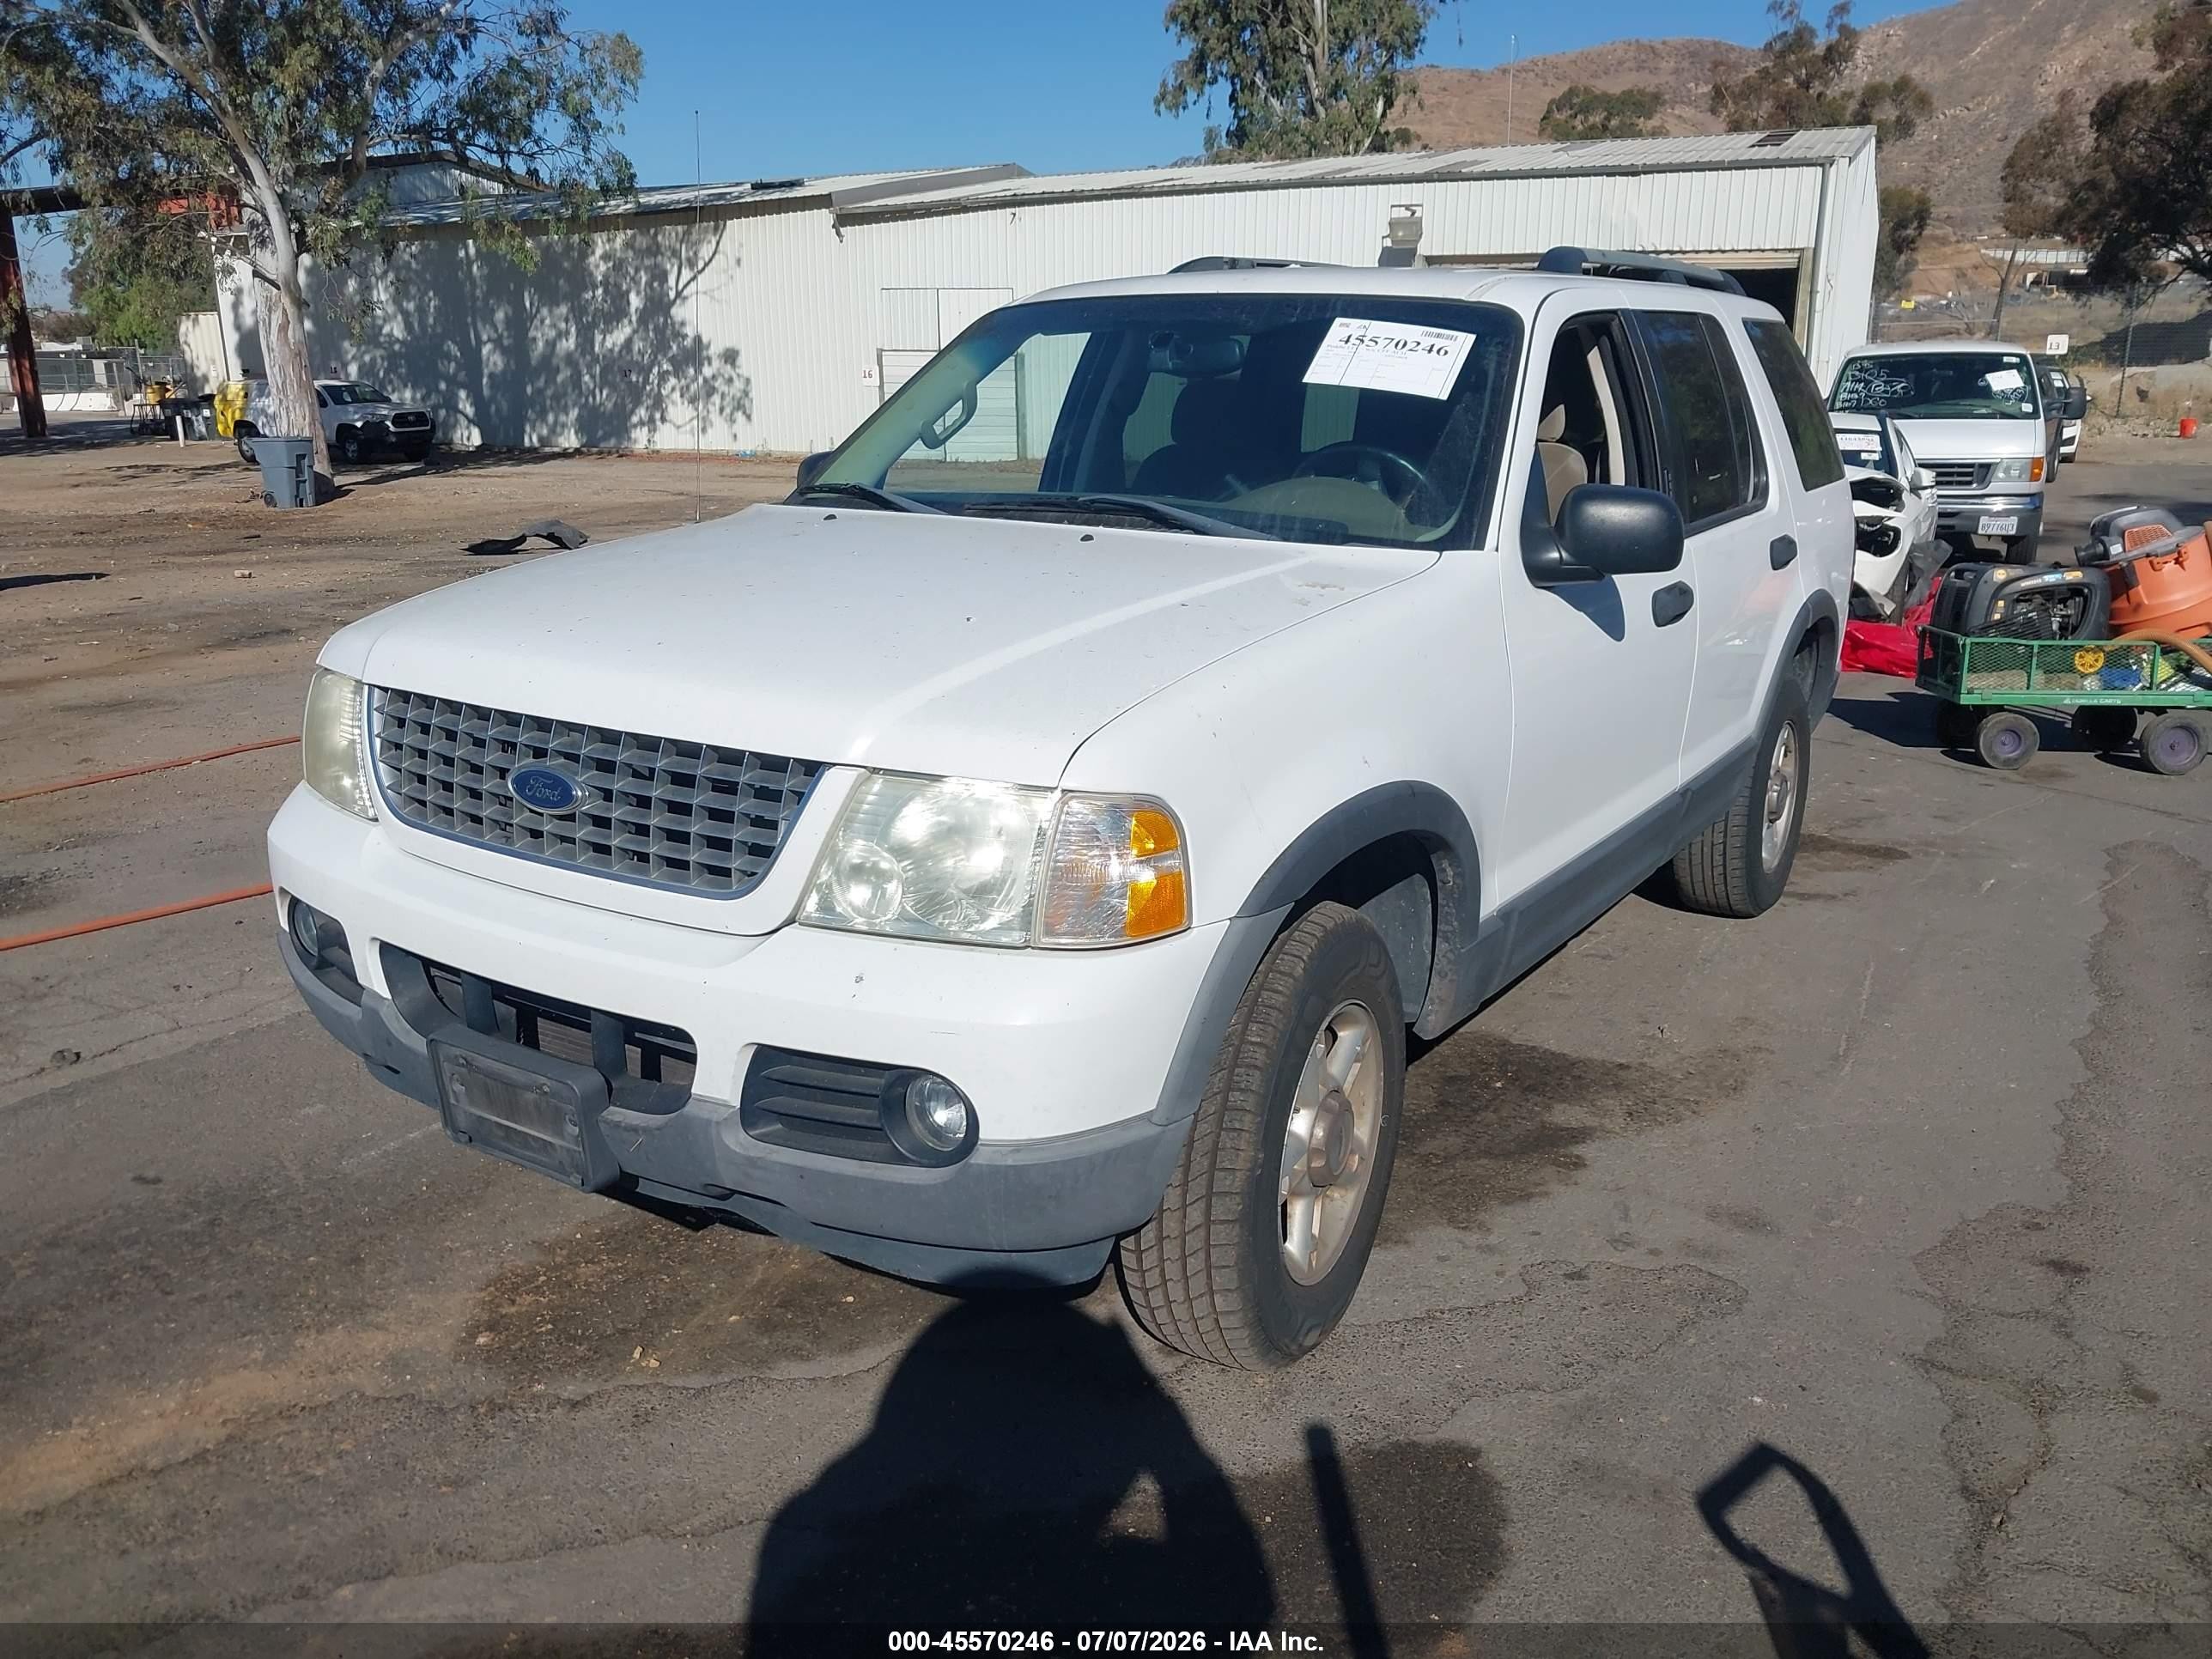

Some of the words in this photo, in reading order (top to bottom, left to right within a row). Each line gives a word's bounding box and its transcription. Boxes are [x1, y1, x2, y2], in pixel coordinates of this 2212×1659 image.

[1339, 333, 1449, 357] 45570246
[2048, 342, 2060, 350] 13
[862, 369, 873, 379] 16
[526, 775, 562, 801] Ford
